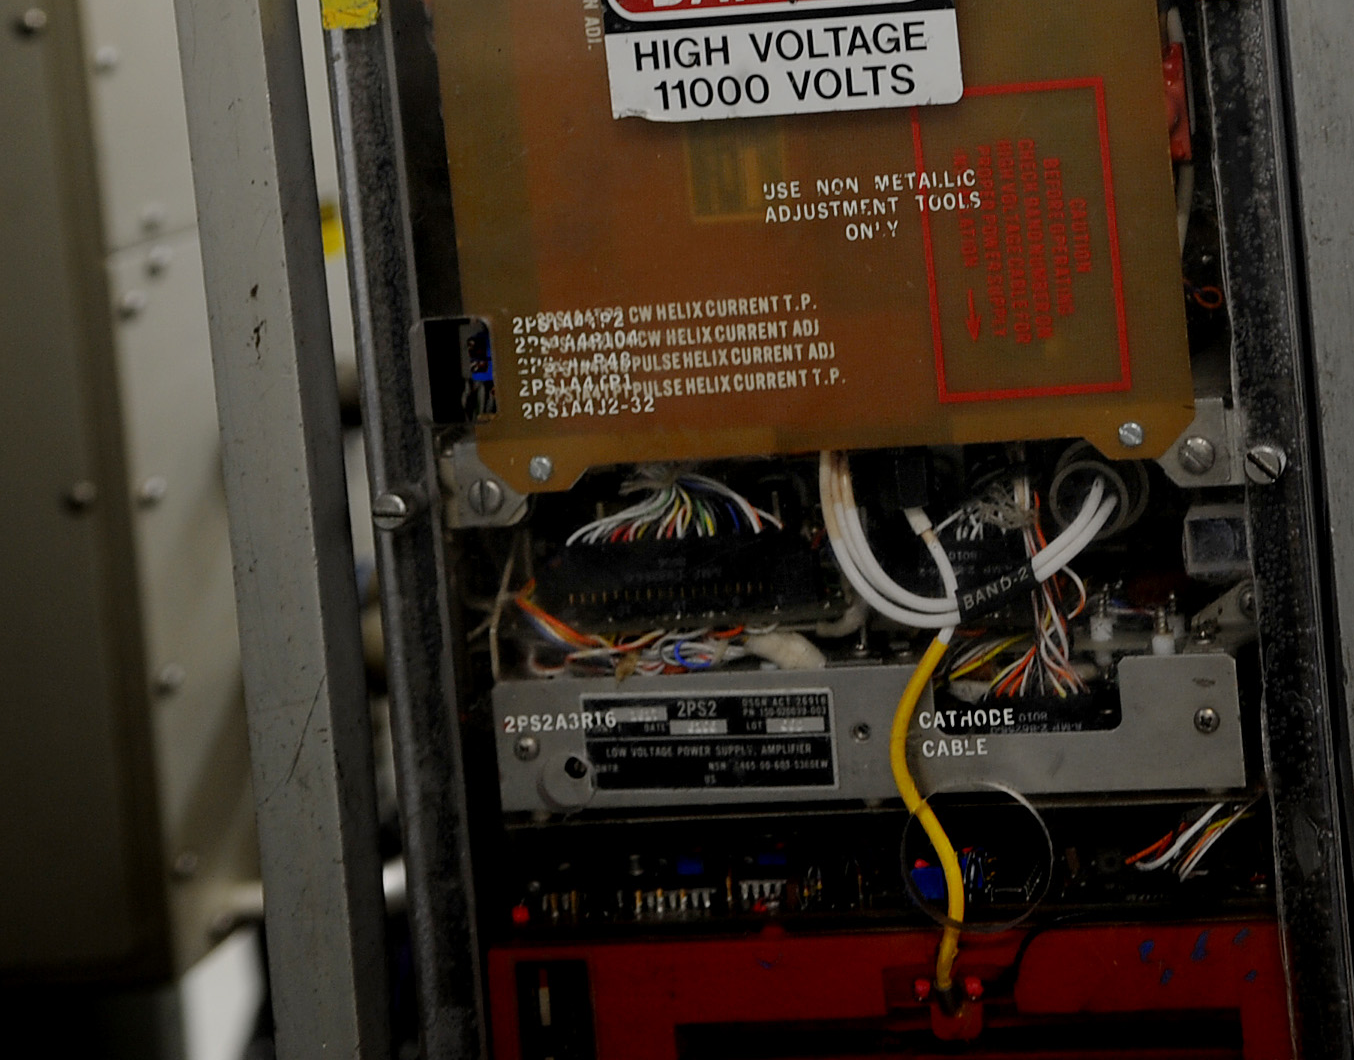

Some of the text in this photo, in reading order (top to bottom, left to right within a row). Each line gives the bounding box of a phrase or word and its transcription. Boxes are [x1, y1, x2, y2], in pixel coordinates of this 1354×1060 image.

[633, 21, 928, 72] HIGH VOLTAGE
[653, 64, 916, 111] 11000 VOLTS
[763, 168, 977, 200] USE NON METALLIC
[1043, 157, 1066, 221] BEFORE
[765, 191, 982, 224] ADJUSTMENT TOOLS
[1068, 196, 1092, 274] CAUTION
[629, 306, 653, 324] CW
[656, 300, 703, 322] HELIX
[706, 295, 780, 318] CURRENT
[782, 293, 818, 313] T.P.
[666, 327, 711, 347] HELIX
[711, 322, 791, 344] CURRENT
[792, 319, 820, 339] ADJ
[631, 352, 681, 372] PULSE
[683, 349, 728, 369] HELIX
[731, 344, 804, 365] CURRENT
[808, 341, 836, 360] ADJ
[631, 378, 682, 399] PULSE
[685, 374, 730, 395] HELIX
[734, 369, 808, 391] CURRENT
[812, 367, 846, 386] T.P.
[521, 396, 656, 420] 2PS1A4J2-32
[963, 565, 1030, 611] BAND-2
[503, 710, 617, 734] 2PS2A3R16
[677, 701, 717, 718] 2PS2
[918, 707, 1016, 730] CATHODE
[606, 746, 628, 758] LOW
[631, 745, 674, 757] VOLTAGE
[677, 744, 711, 757] POWER
[760, 743, 812, 755] AMPLIFIER
[922, 738, 989, 758] CABLE
